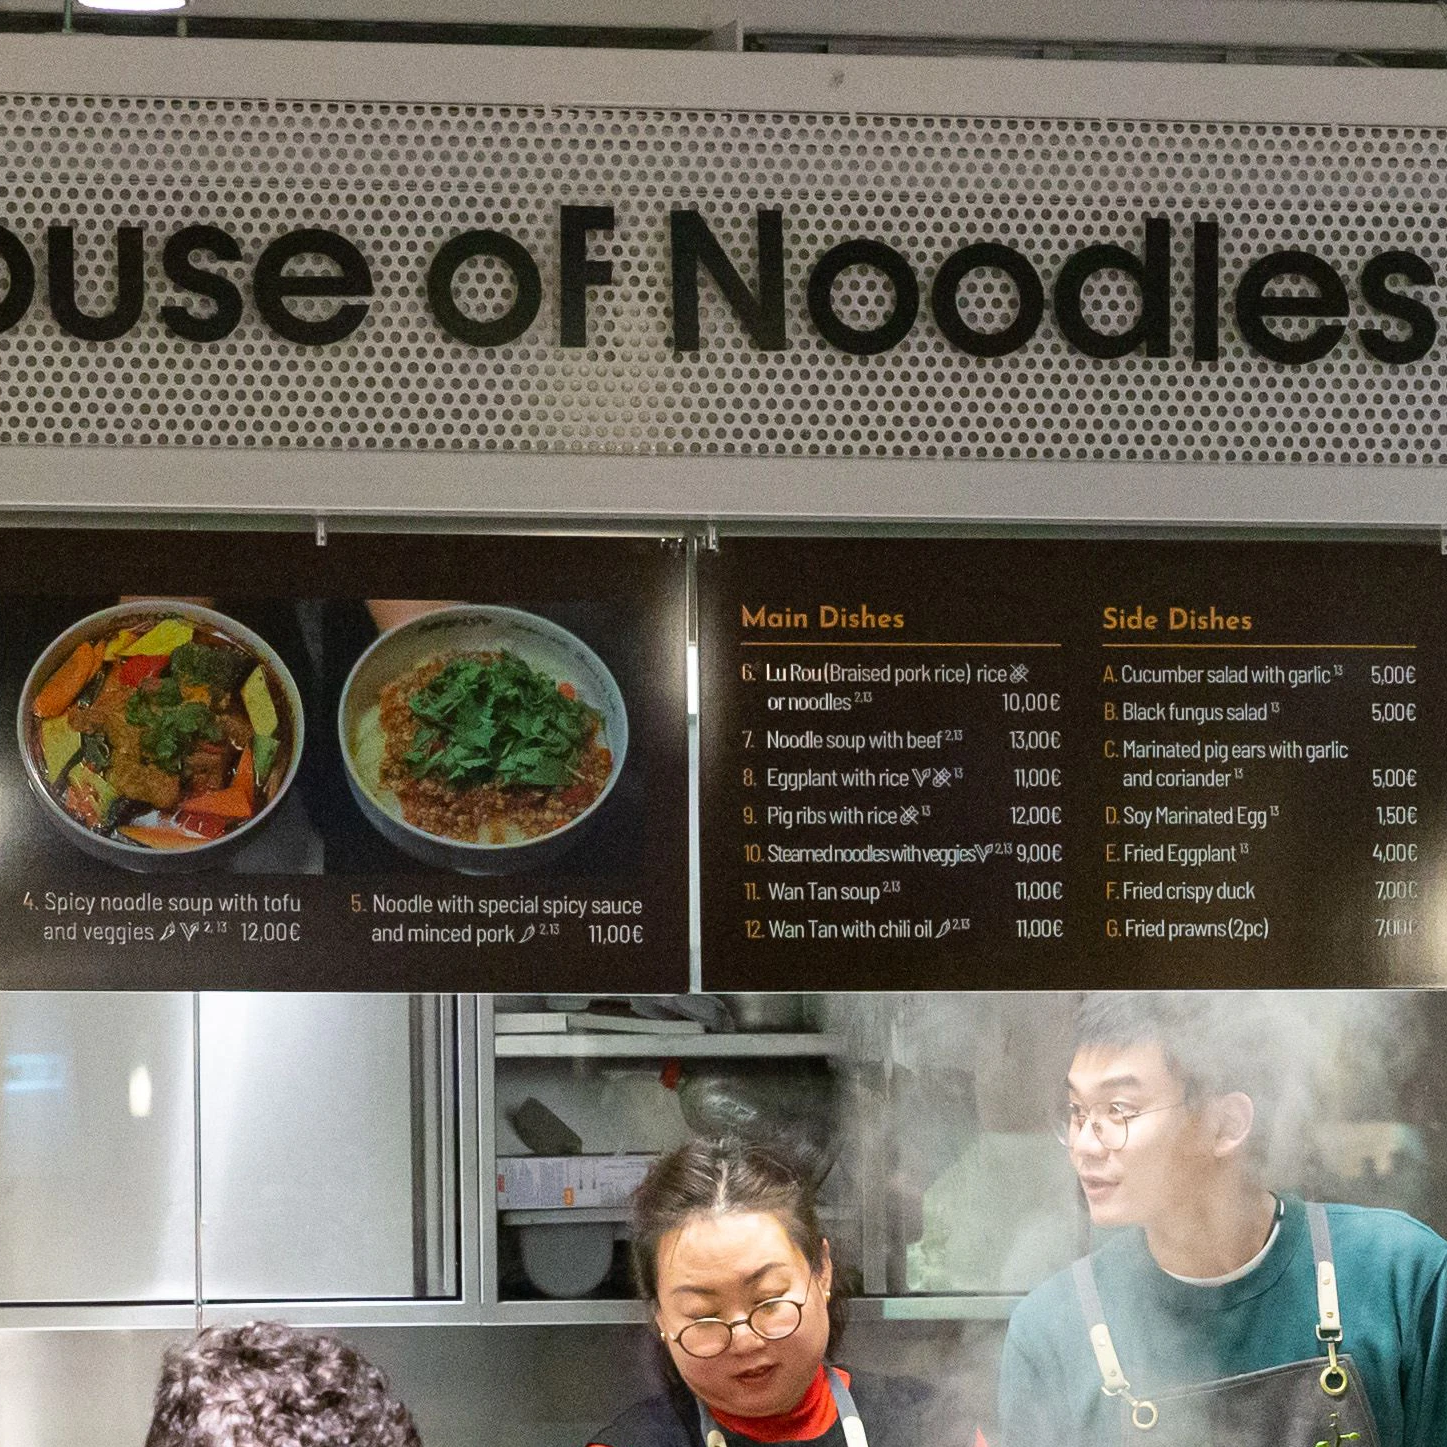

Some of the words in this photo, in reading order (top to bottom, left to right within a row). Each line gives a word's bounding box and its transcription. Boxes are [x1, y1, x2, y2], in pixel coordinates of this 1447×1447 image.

[668, 208, 1438, 365] Noodles
[741, 604, 807, 628] Main
[820, 604, 904, 628] Dishes
[1103, 606, 1158, 629] Side
[1169, 606, 1252, 630] Dishes
[766, 663, 787, 681] Lu
[895, 663, 931, 684] pork
[935, 663, 971, 684] rice)
[977, 664, 1007, 682] rice
[1104, 665, 1117, 683] A.
[1122, 664, 1203, 683] Cucumber
[1207, 664, 1247, 683] salad
[1251, 665, 1285, 683] with
[1289, 665, 1331, 688] garlic
[1371, 665, 1416, 685] 5,00€
[768, 695, 784, 710] or
[788, 692, 851, 711] noodles
[1002, 692, 1061, 712] 10,00€
[1105, 703, 1118, 720] B.
[1123, 702, 1165, 721] Black
[1169, 702, 1223, 724] fungus
[1227, 702, 1267, 721] salad
[1372, 703, 1416, 722] 5,00€
[767, 730, 823, 749] Noodle
[826, 735, 865, 752] soup
[869, 730, 903, 749] with
[907, 730, 943, 749] beef
[1010, 730, 1061, 750] 13,00€
[1123, 740, 1201, 759] Marinated
[1204, 740, 1228, 763] pig
[1232, 745, 1265, 759] ears
[1269, 740, 1302, 759] with
[1306, 740, 1348, 762] garlic
[743, 768, 756, 786] 8.
[768, 768, 837, 791] Eggplant
[841, 768, 875, 786] with
[879, 768, 909, 786] rice
[1014, 768, 1061, 788] 11,00€
[1123, 768, 1152, 786] and
[1156, 768, 1231, 786] coriander
[1372, 768, 1417, 788] 5,00€
[768, 806, 793, 829] Pig
[796, 805, 826, 824] ribs
[830, 805, 864, 824] with
[868, 807, 897, 824] rice
[1010, 805, 1061, 826] 12,00€
[1124, 807, 1152, 829] Soy
[1156, 805, 1234, 824] Marinated
[1237, 806, 1267, 829] Egg
[1376, 806, 1417, 826] 1,50€
[768, 843, 833, 862] Steamed
[834, 843, 890, 862] noodles
[891, 843, 922, 862] with
[1017, 843, 1062, 863] 9,00€
[1124, 843, 1164, 862] Fried
[1168, 843, 1236, 866] Eggplant
[1373, 843, 1418, 863] 4,00€
[45, 891, 95, 915] Spicy
[101, 891, 163, 912] noodle
[168, 897, 213, 916] soup
[218, 892, 258, 912] with
[264, 892, 301, 912] tofu
[769, 881, 804, 900] Wan
[808, 881, 837, 900] Tan
[841, 887, 881, 904] soup
[1015, 881, 1062, 901] 11,00€
[1123, 880, 1163, 899] Fried
[1166, 881, 1213, 904] crispy
[1217, 880, 1255, 899] duck
[351, 893, 366, 912] 5.
[373, 893, 433, 913] Noodle
[437, 894, 474, 913] with
[478, 894, 538, 918] special
[543, 895, 587, 918] spicy
[591, 900, 642, 914] sauce
[44, 922, 77, 940] and
[83, 923, 153, 945] veggies
[241, 922, 301, 942] 12,00€
[372, 923, 403, 942] and
[408, 924, 472, 942] minced
[476, 925, 515, 947] pork
[589, 925, 643, 944] 11,00€
[745, 920, 764, 937] 12.
[769, 919, 804, 938] Wan
[808, 919, 838, 938] Tan
[842, 919, 875, 938] with
[879, 918, 911, 938] chili
[915, 918, 932, 938] oil
[1016, 918, 1063, 939] 11,00€
[1125, 918, 1165, 937] Fried
